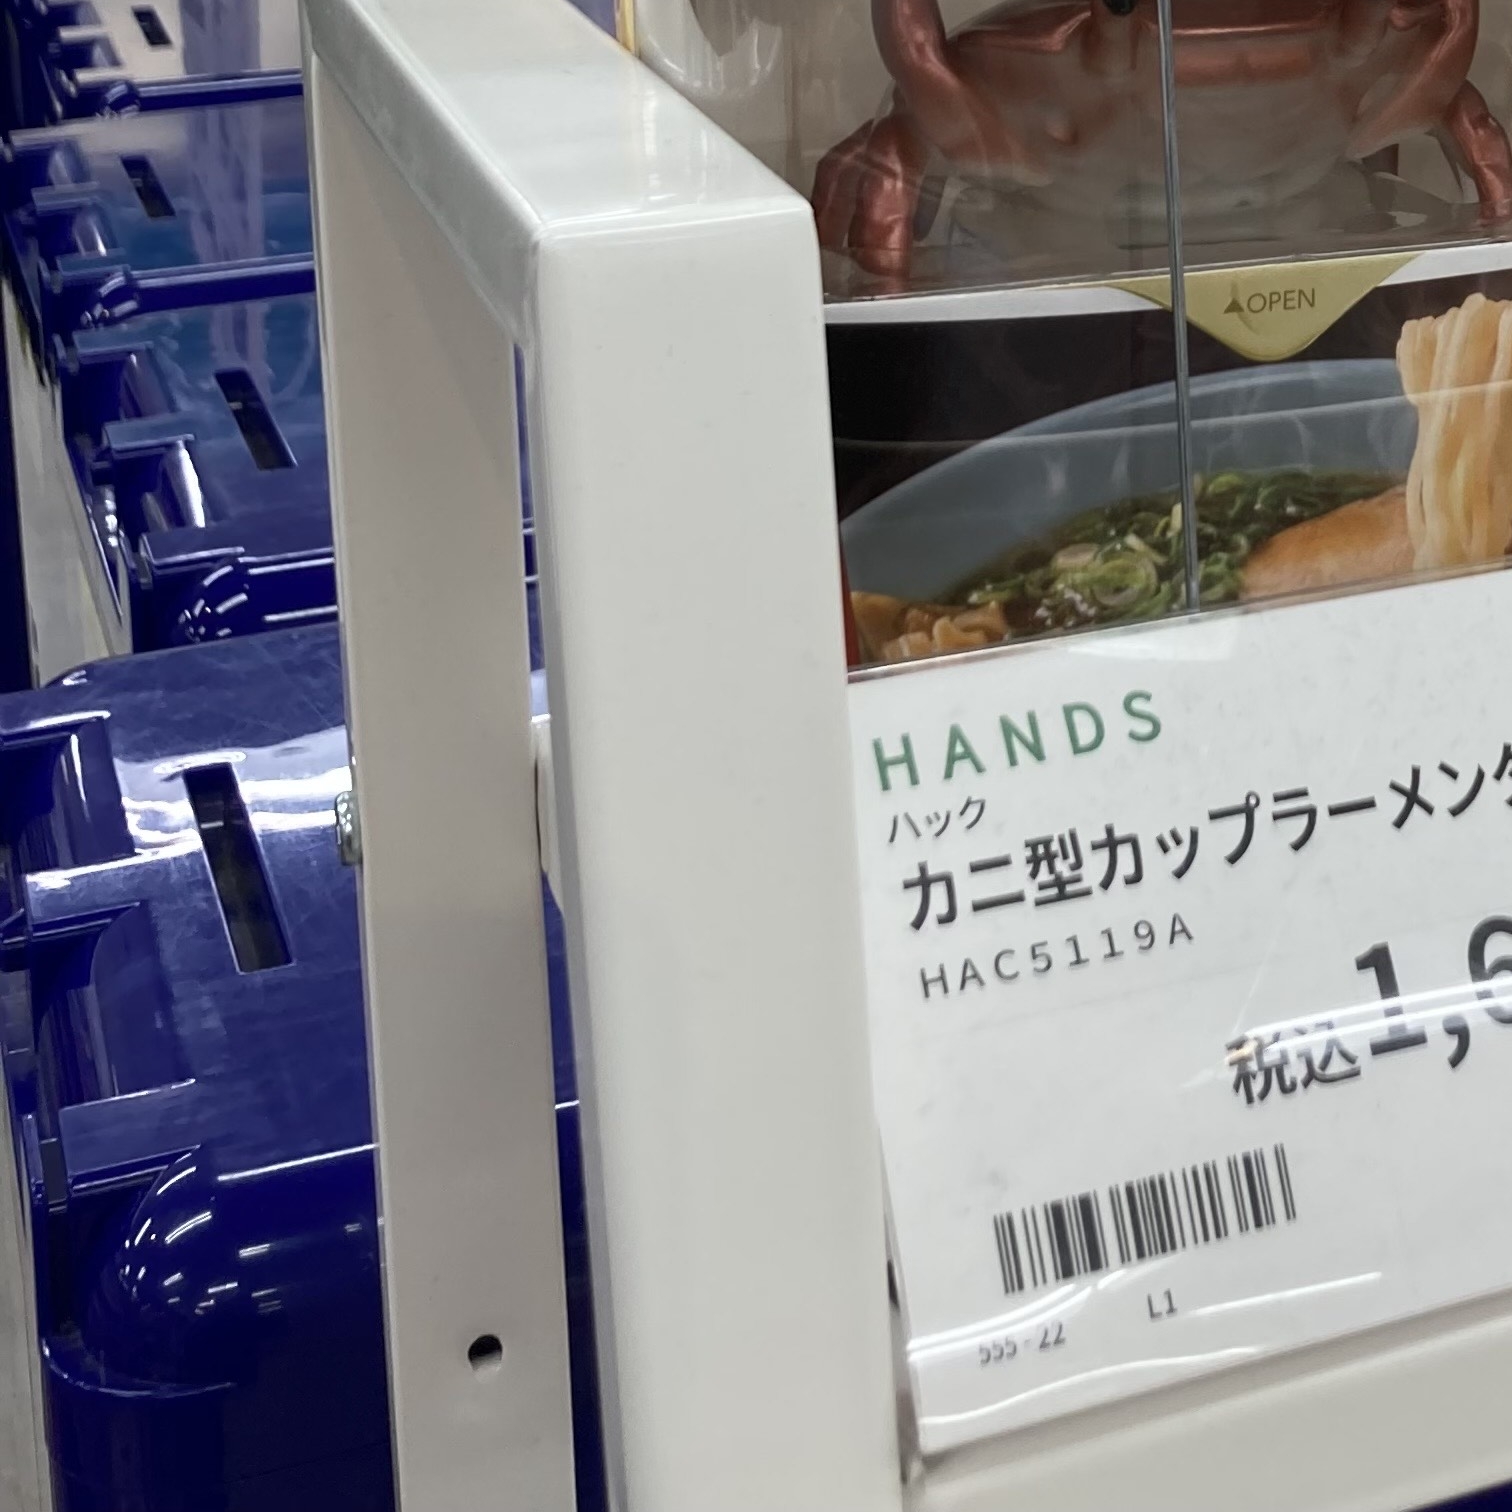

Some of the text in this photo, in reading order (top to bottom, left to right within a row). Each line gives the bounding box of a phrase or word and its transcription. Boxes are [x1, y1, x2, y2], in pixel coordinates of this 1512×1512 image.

[1247, 288, 1316, 314] OPEN
[872, 689, 1162, 791] HANDS
[887, 795, 987, 843] ハック
[919, 912, 1195, 999] HAC5119A
[1147, 1288, 1178, 1320] L1
